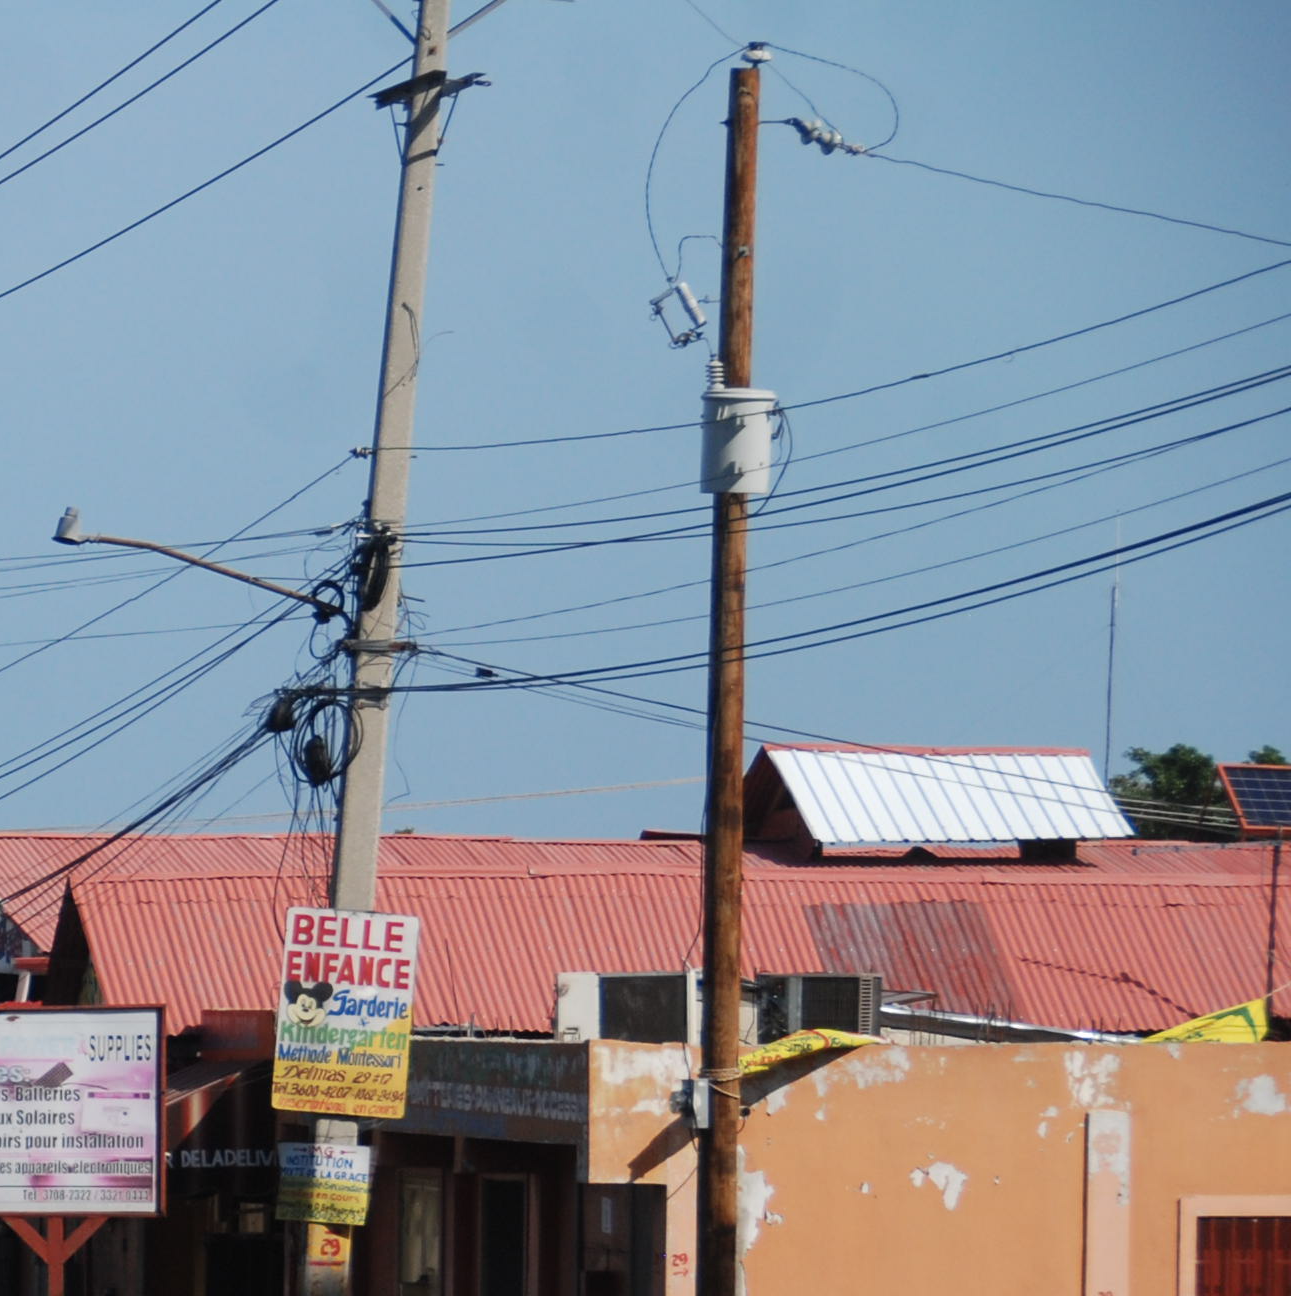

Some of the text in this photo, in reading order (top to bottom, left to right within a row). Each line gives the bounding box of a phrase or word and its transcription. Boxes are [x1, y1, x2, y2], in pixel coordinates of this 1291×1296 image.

[292, 914, 405, 953] BELLE
[286, 951, 410, 990] ENFANCE
[328, 990, 408, 1019] Garderie
[90, 1035, 152, 1062] SUPPLIES
[279, 1020, 407, 1051] Kindergarten
[16, 1111, 75, 1125] Solaires
[25, 1138, 57, 1151] pour
[62, 1134, 144, 1150] installation
[180, 1149, 277, 1168] DELADELIV
